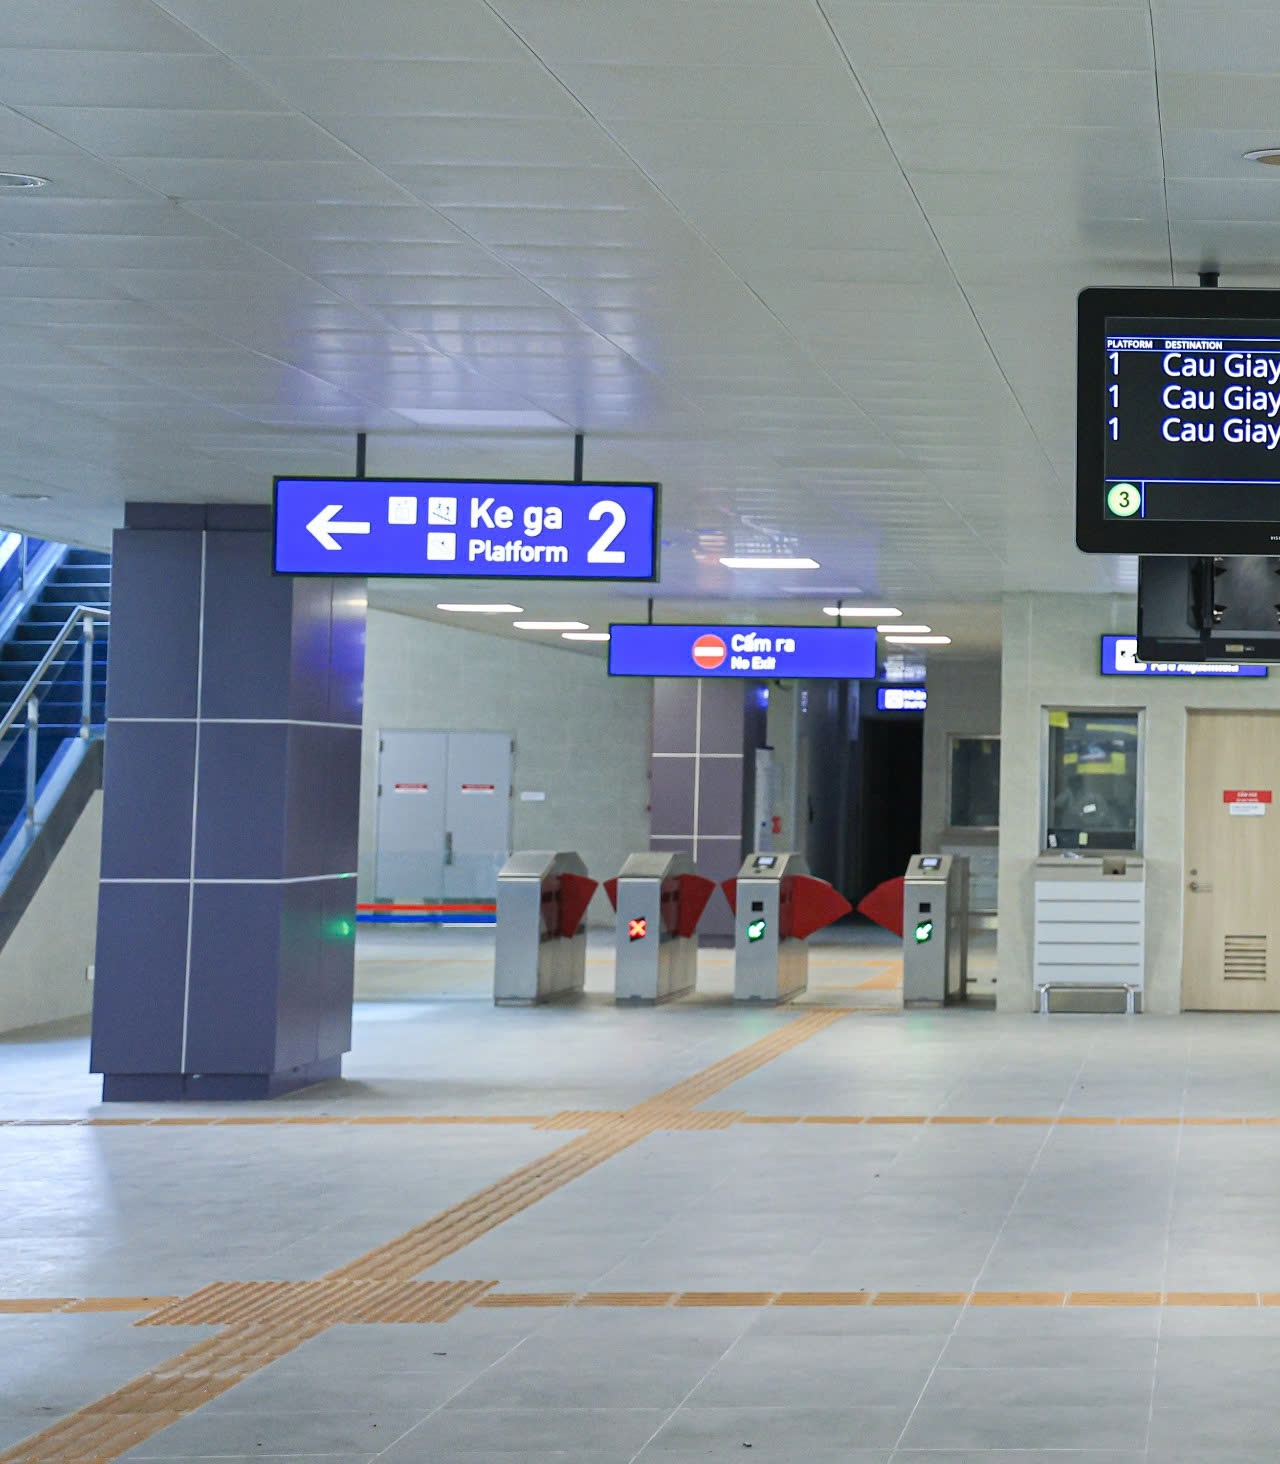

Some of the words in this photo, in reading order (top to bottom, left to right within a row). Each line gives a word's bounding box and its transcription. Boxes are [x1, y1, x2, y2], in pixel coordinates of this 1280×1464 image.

[1107, 340, 1153, 349] PLATFORM
[1165, 341, 1222, 350] DESTINATION
[1108, 352, 1119, 376] 1
[1163, 353, 1215, 377] Cau
[1108, 384, 1119, 408] 1
[1162, 385, 1215, 410] Cau
[1108, 417, 1119, 441] 1
[1162, 418, 1214, 443] Cau
[1119, 491, 1130, 508] 3
[470, 497, 514, 529] Ke
[523, 506, 563, 537] ga
[586, 499, 627, 564] 2
[468, 538, 569, 563] Platform
[775, 638, 796, 653] ra
[730, 655, 751, 670] No
[751, 655, 777, 670] Exit
